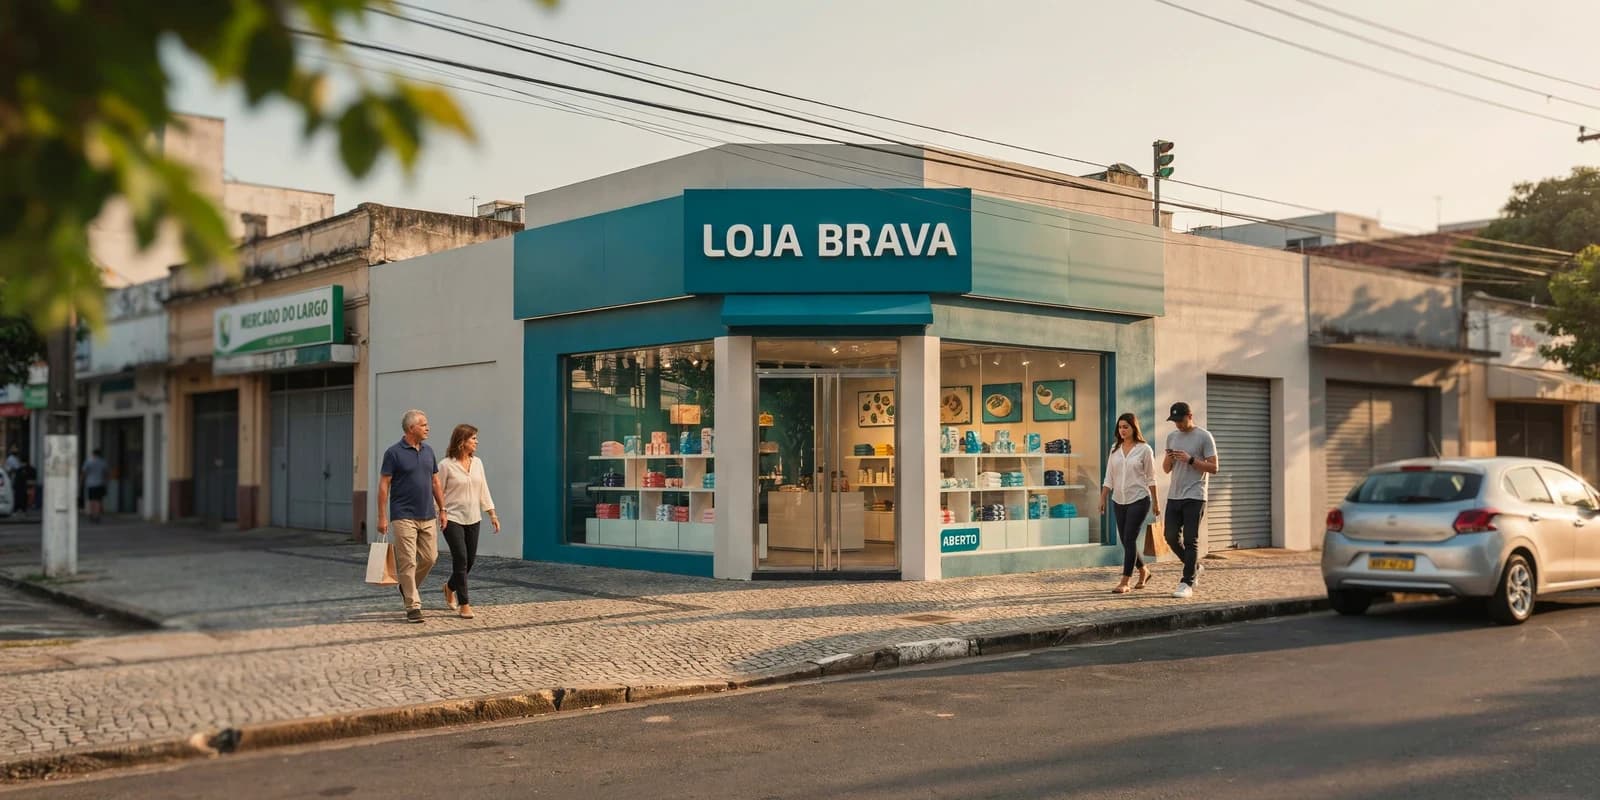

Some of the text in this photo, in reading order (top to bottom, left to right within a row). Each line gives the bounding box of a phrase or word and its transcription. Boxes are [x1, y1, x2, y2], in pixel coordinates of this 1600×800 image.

[703, 222, 957, 257] LOJA BRAVA
[241, 299, 328, 328] MERCADO DO LARGO
[943, 534, 977, 546] ABERTO
